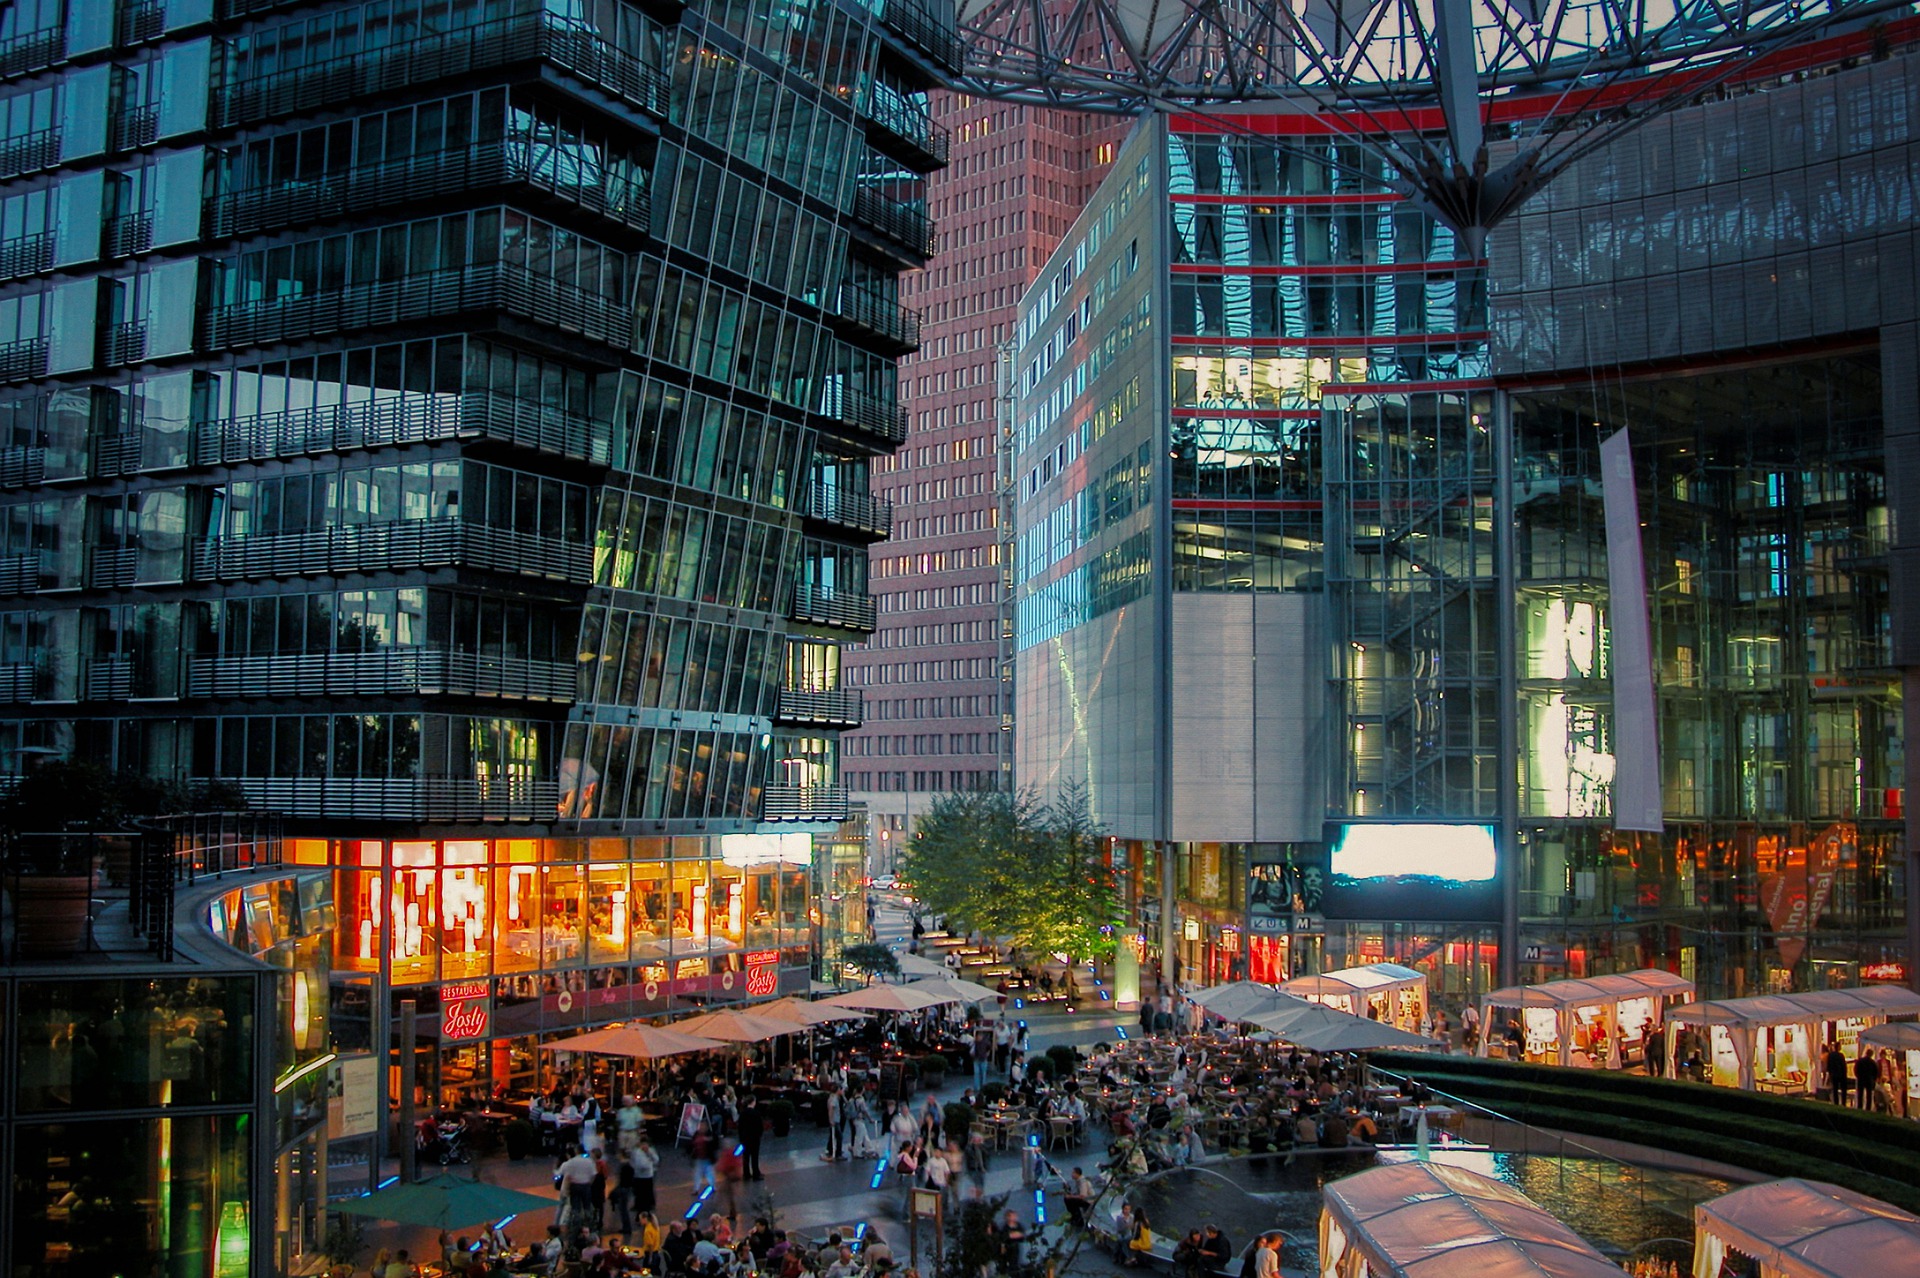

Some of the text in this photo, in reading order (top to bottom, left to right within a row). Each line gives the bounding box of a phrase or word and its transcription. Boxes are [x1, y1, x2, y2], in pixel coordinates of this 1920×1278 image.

[1296, 918, 1308, 929] M
[1525, 947, 1539, 959] M
[443, 985, 488, 998] RESTAURANT
